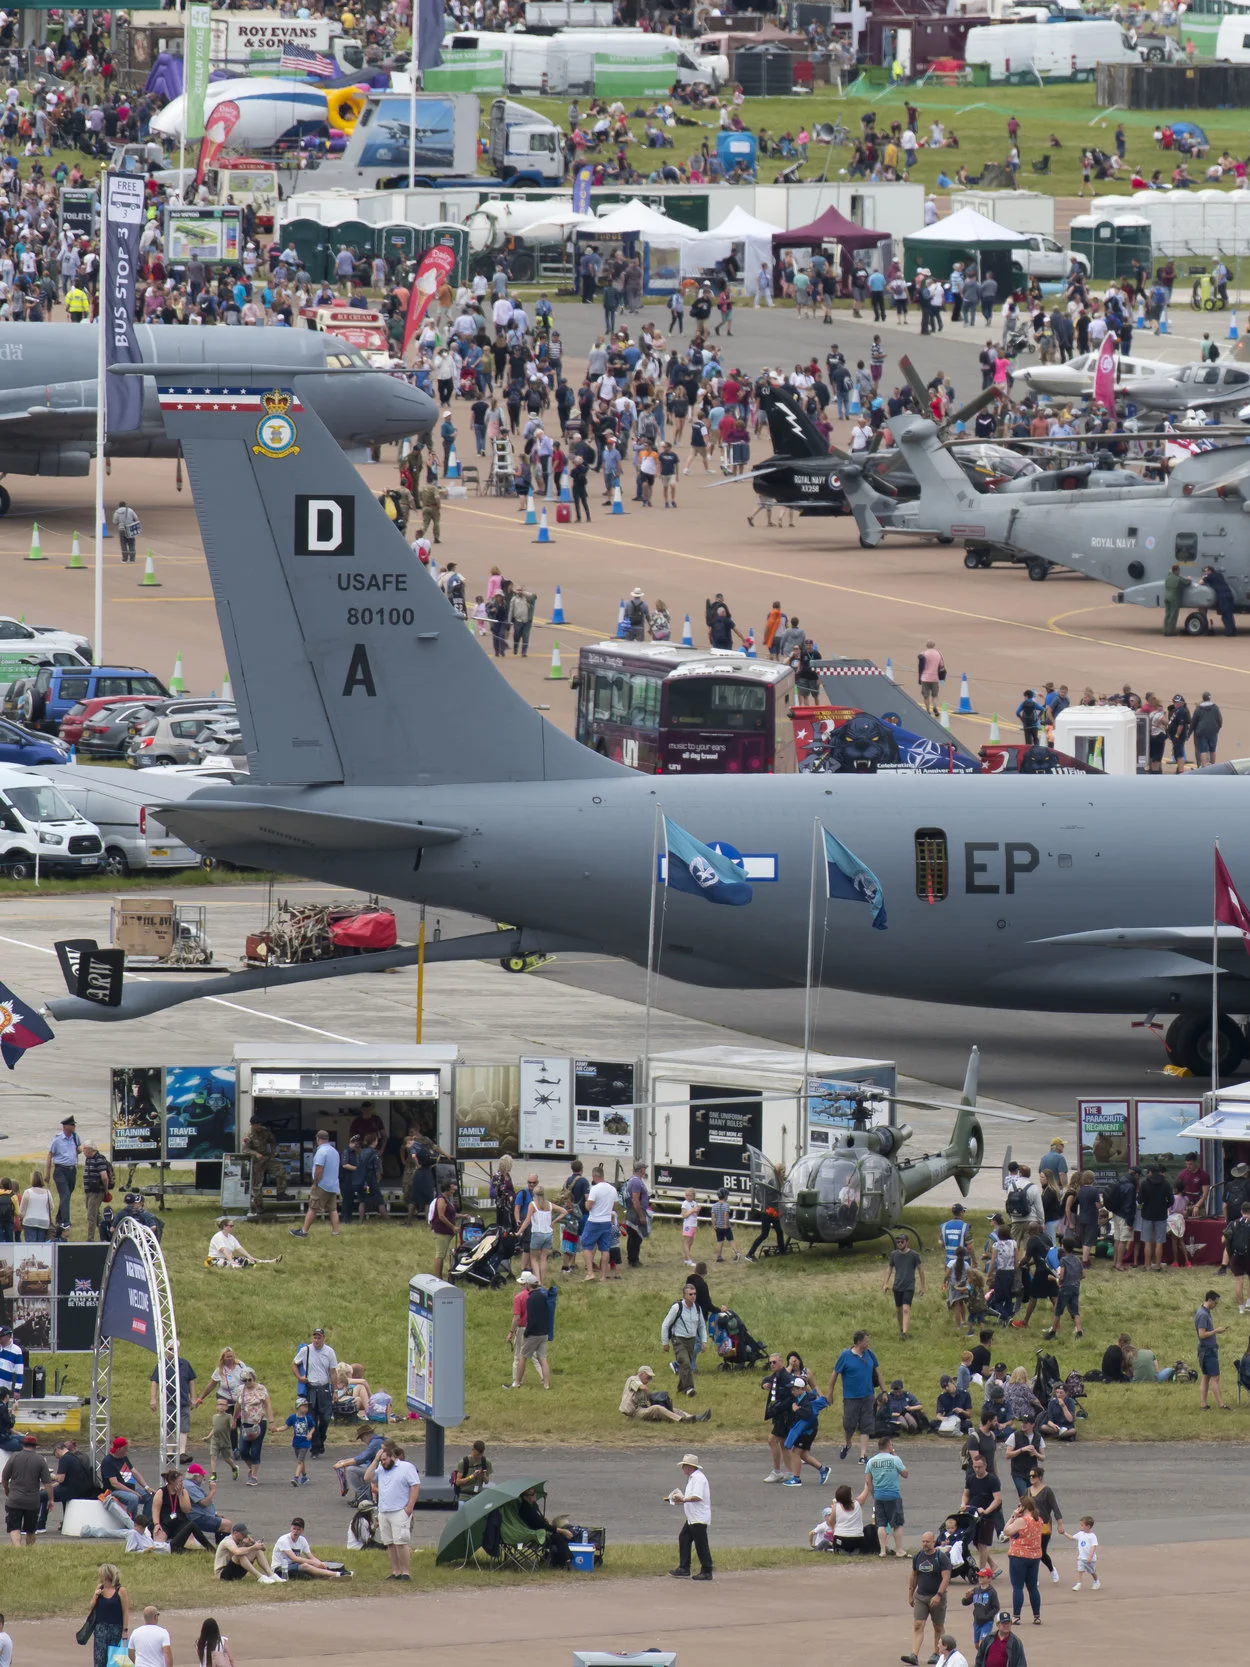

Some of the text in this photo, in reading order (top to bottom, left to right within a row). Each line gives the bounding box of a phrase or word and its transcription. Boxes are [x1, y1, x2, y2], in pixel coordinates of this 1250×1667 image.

[238, 26, 317, 38] ROY EVANS
[244, 38, 255, 48] &
[117, 180, 137, 191] FREE
[63, 212, 92, 221] TOILETS
[114, 228, 129, 347] BUS STOP 3
[794, 475, 827, 484] ROYAL NAVY
[308, 500, 342, 550] D
[1091, 537, 1136, 548] ROYAL NAVY
[337, 573, 407, 591] USAFE
[347, 607, 414, 626] 80100
[342, 643, 377, 697] A
[668, 742, 688, 750] music
[696, 744, 711, 752] your
[691, 753, 701, 761] day
[965, 842, 1040, 894] EP
[709, 1118, 726, 1126] MANY
[1085, 1123, 1119, 1131] REGIMENT
[116, 1128, 150, 1136] TRAINING
[169, 1127, 197, 1135] TRAVEL
[458, 1127, 486, 1135] FAMILY
[723, 1175, 737, 1189] BE
